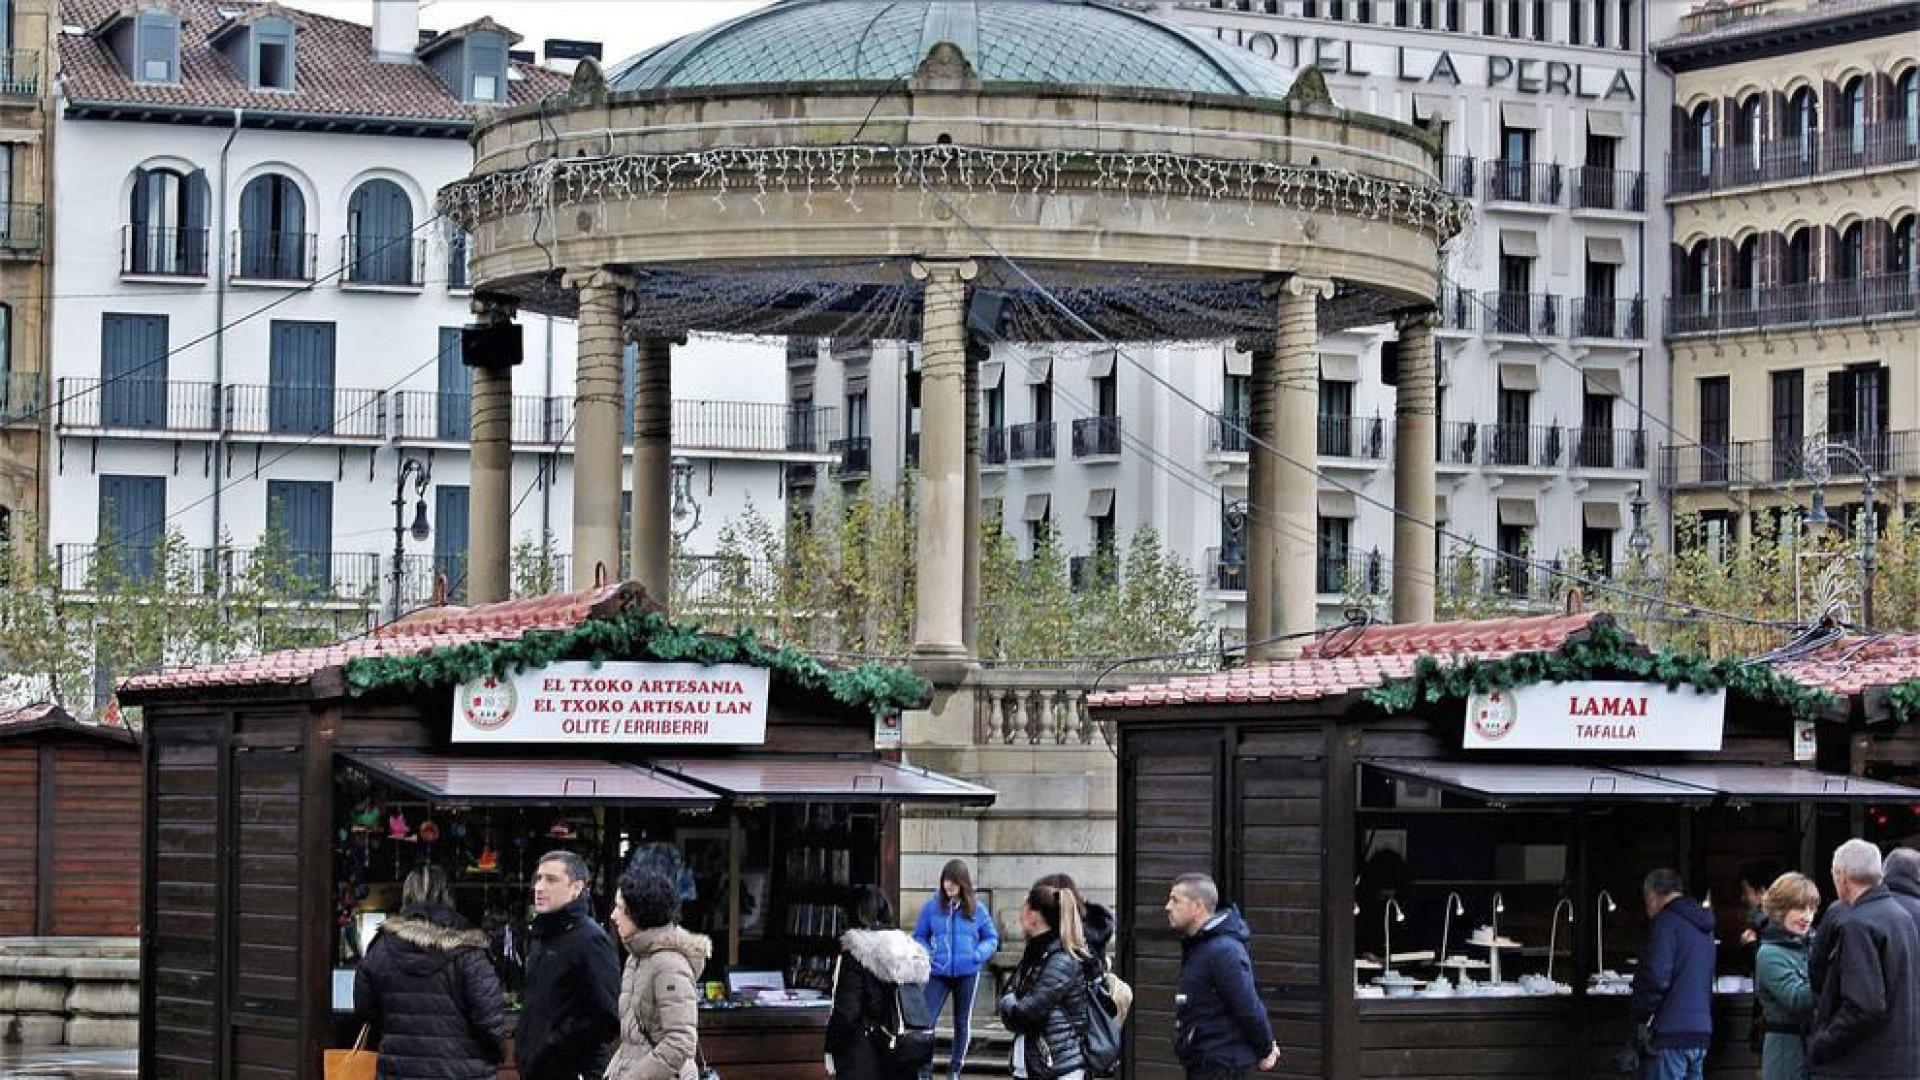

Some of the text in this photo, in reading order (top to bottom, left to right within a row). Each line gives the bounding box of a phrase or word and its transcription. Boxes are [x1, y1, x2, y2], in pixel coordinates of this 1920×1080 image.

[1398, 46, 1461, 85] LA
[1488, 55, 1635, 101] PERLA
[543, 679, 743, 694] EL TXOKO ARTESANIA
[534, 700, 752, 714] EL TXOKO ARTISAU LAN
[1569, 696, 1648, 716] LAMAI
[562, 719, 609, 734] OLITE
[624, 719, 708, 734] ERRIBERRI
[1576, 725, 1636, 738] TAFALLA
